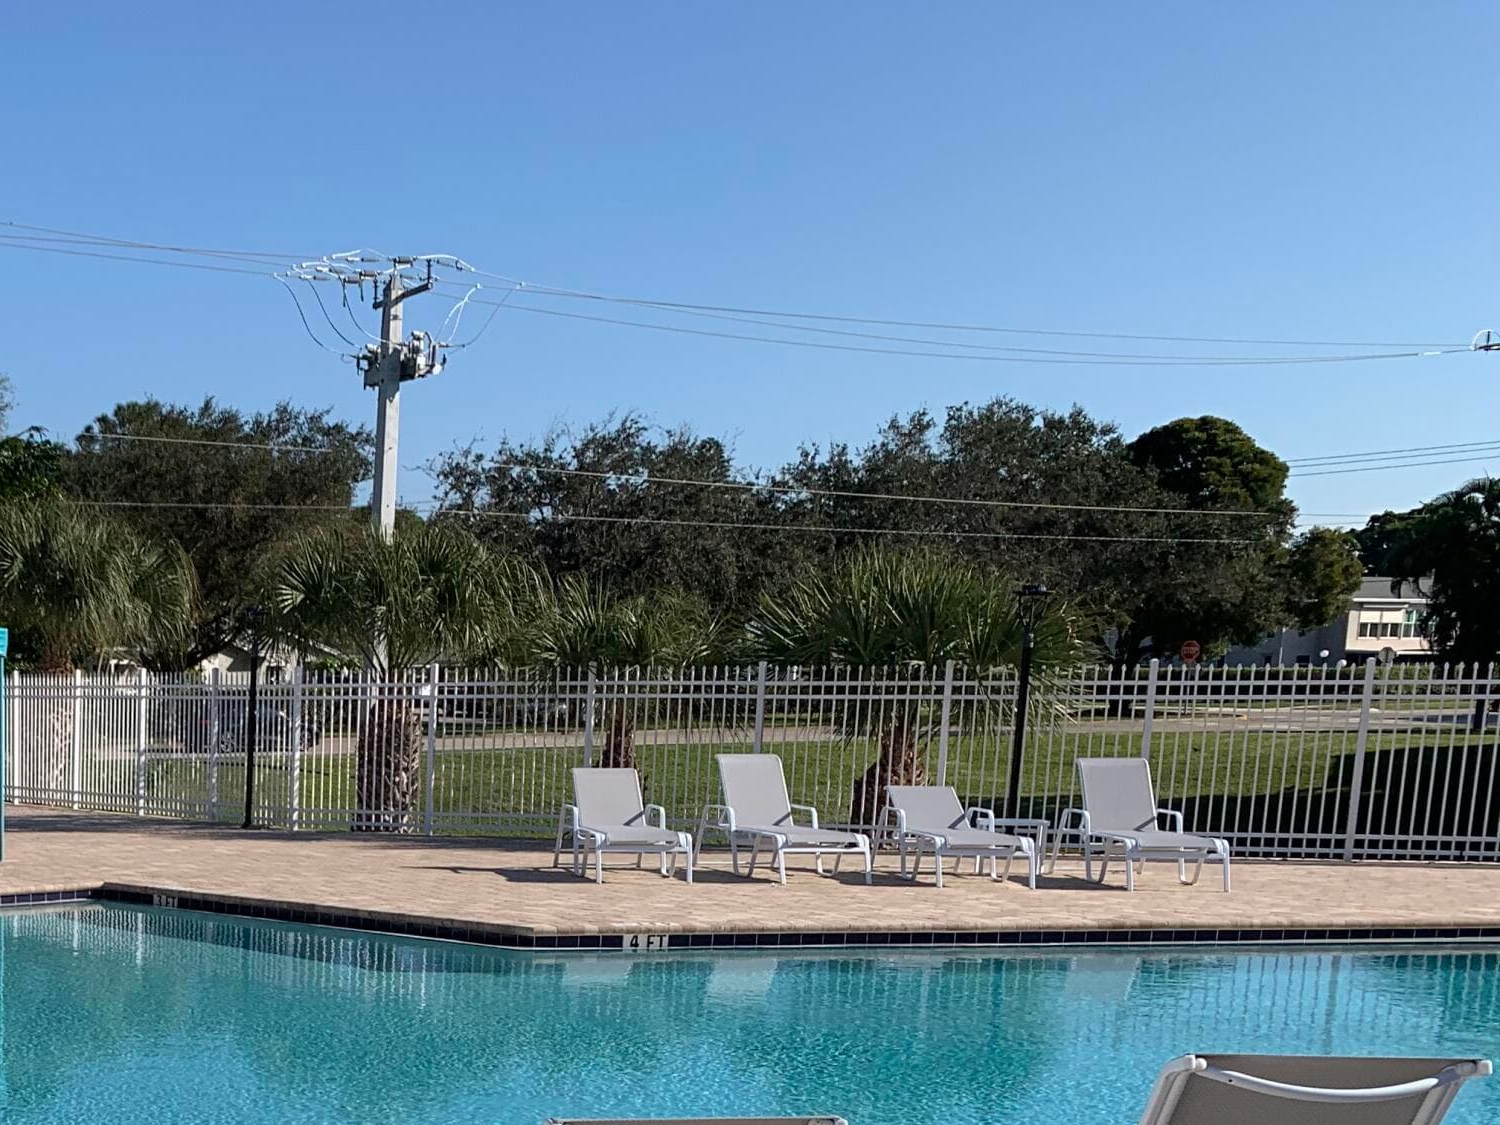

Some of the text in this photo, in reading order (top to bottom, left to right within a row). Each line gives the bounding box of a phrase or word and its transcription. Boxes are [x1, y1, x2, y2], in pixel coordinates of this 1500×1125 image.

[1182, 646, 1199, 655] STOP
[165, 895, 178, 907] FT
[630, 934, 667, 949] 4 FT
